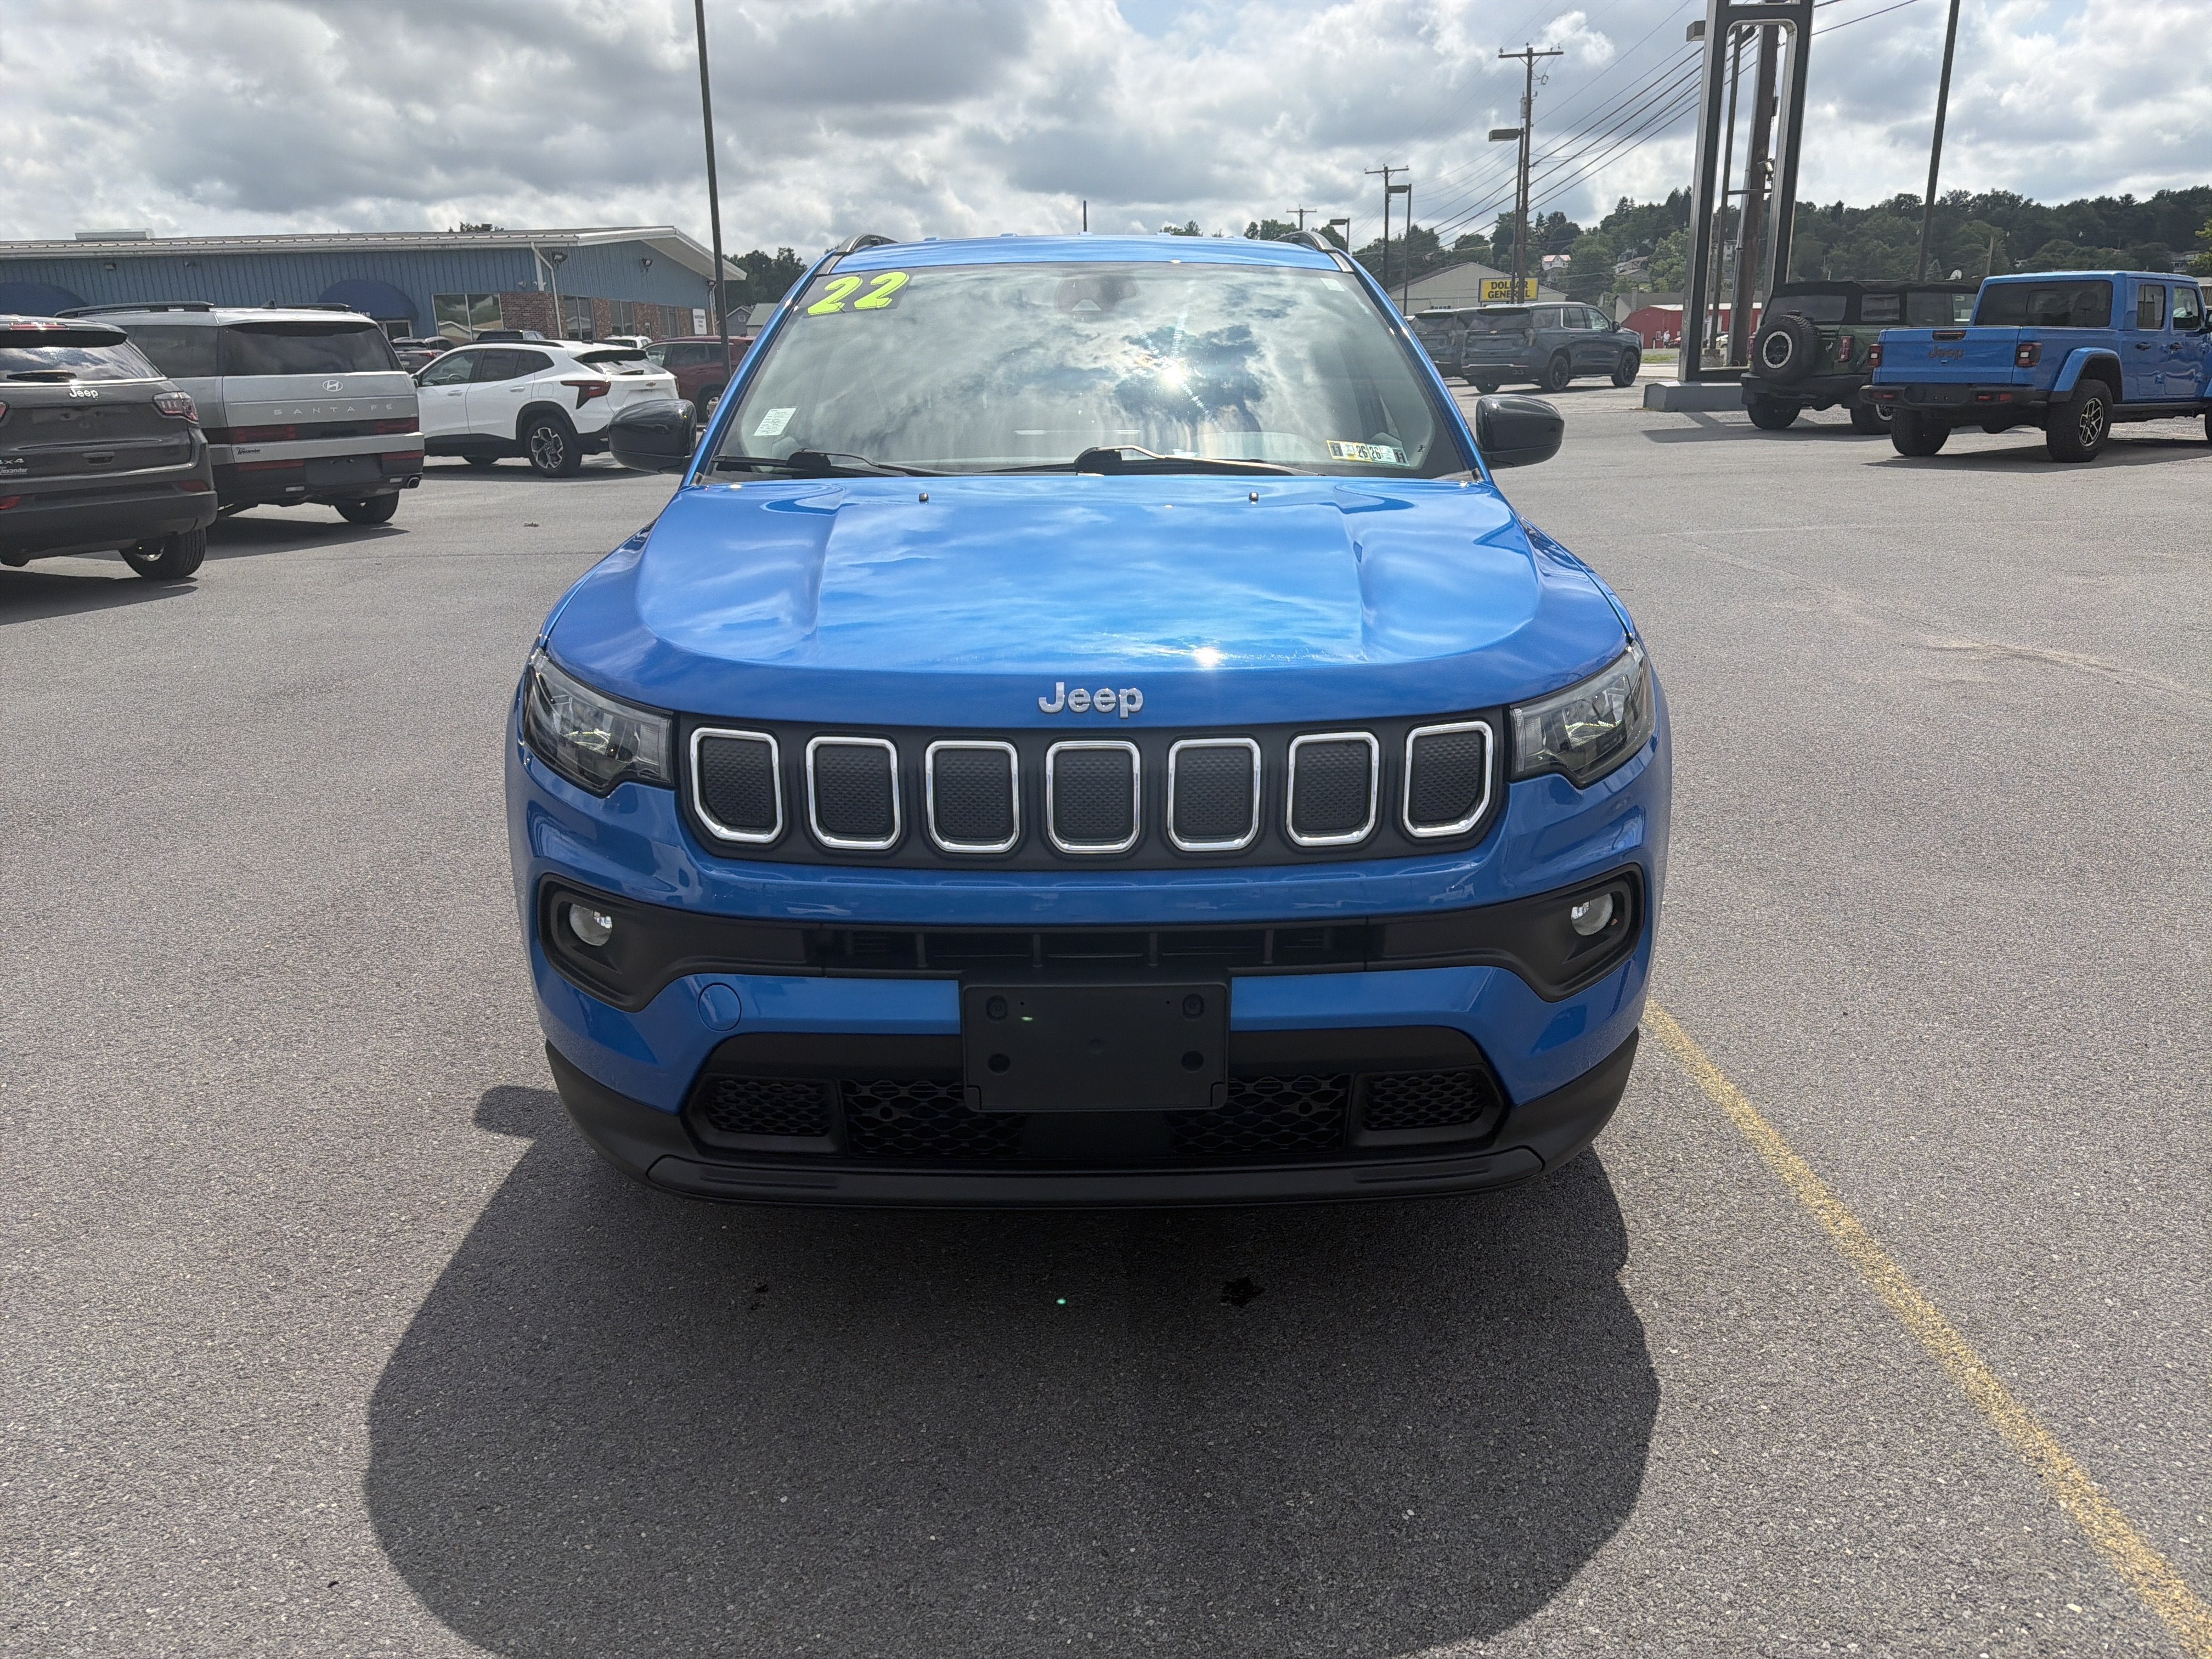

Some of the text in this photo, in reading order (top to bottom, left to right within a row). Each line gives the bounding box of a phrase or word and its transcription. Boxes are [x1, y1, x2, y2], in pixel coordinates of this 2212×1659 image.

[808, 272, 910, 315] 22
[1927, 345, 1965, 360] Jeep
[69, 388, 99, 399] Jeep
[274, 406, 356, 415] SANTA
[1356, 445, 1368, 459] 26
[1369, 446, 1407, 464] 26 11
[1038, 681, 1144, 719] Jeep
